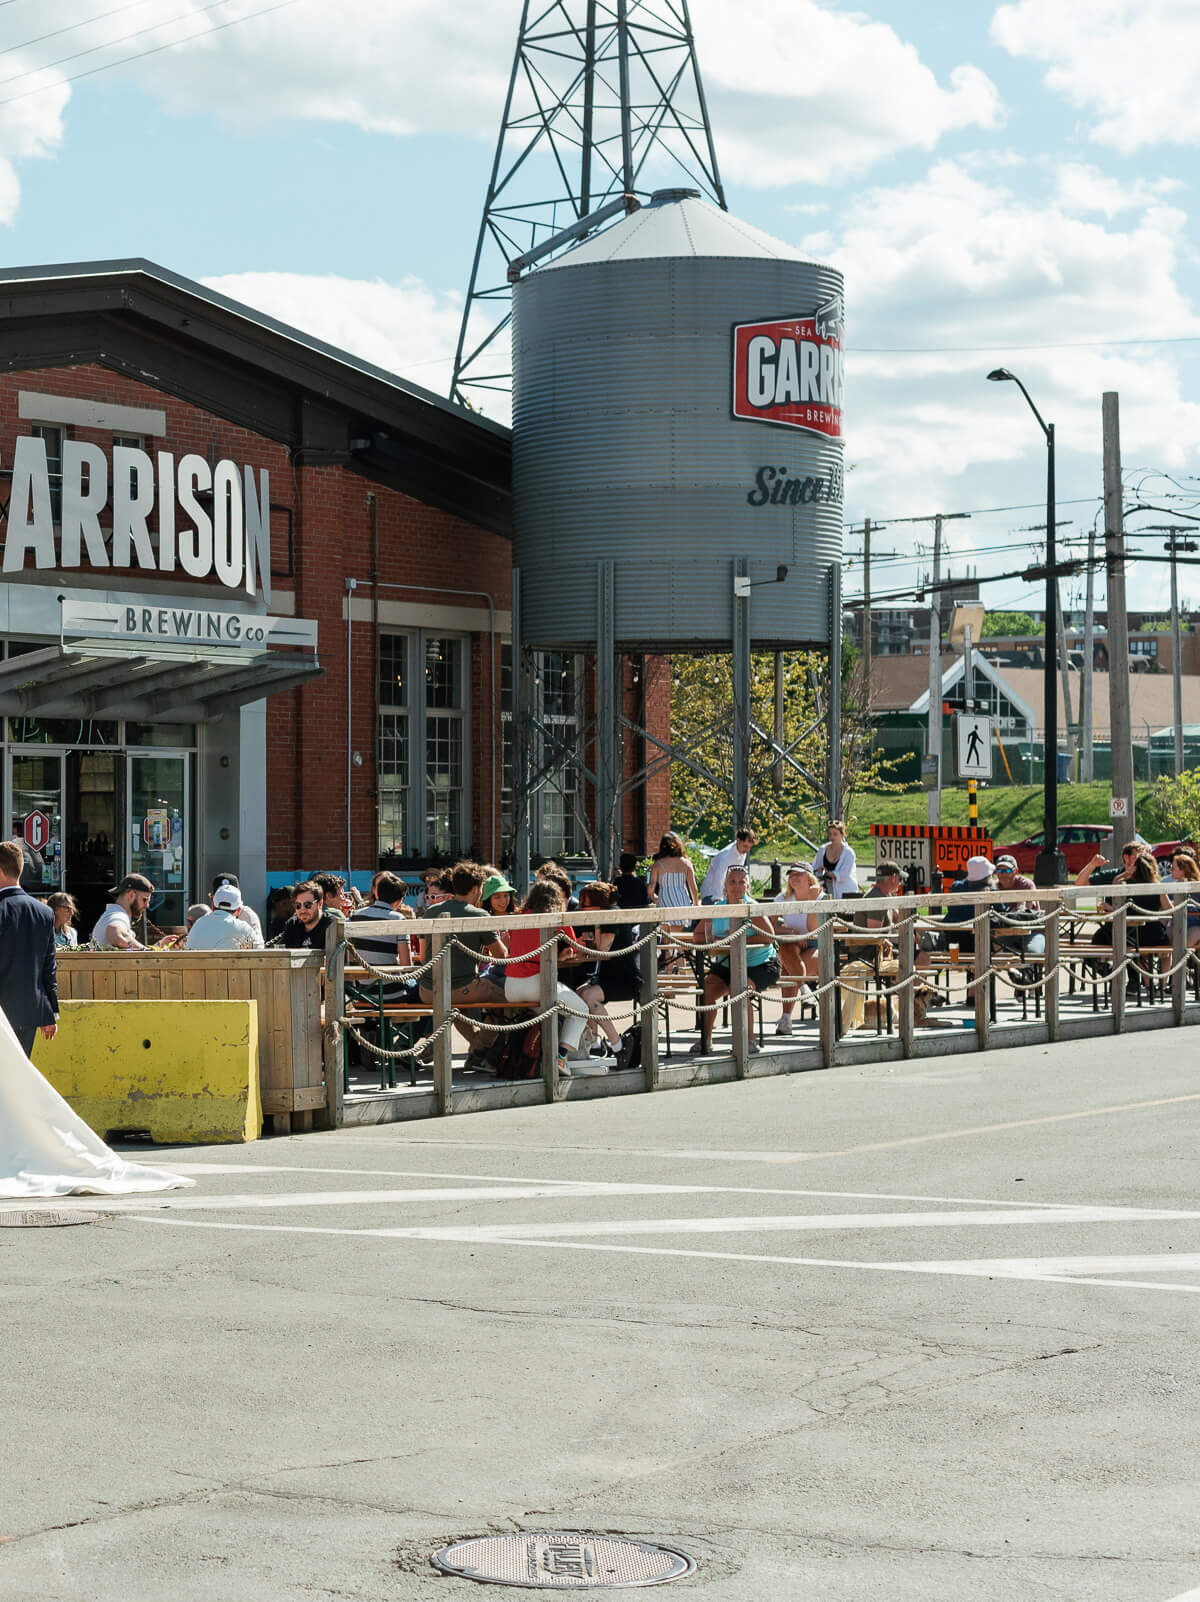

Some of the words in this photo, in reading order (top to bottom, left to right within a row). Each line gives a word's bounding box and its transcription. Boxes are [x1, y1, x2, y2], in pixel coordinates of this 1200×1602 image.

[795, 325, 812, 337] SEA
[747, 466, 824, 507] Since
[126, 607, 241, 640] BREWING
[31, 815, 43, 847] G
[880, 839, 925, 860] STREET
[938, 843, 988, 861] DETOUR
